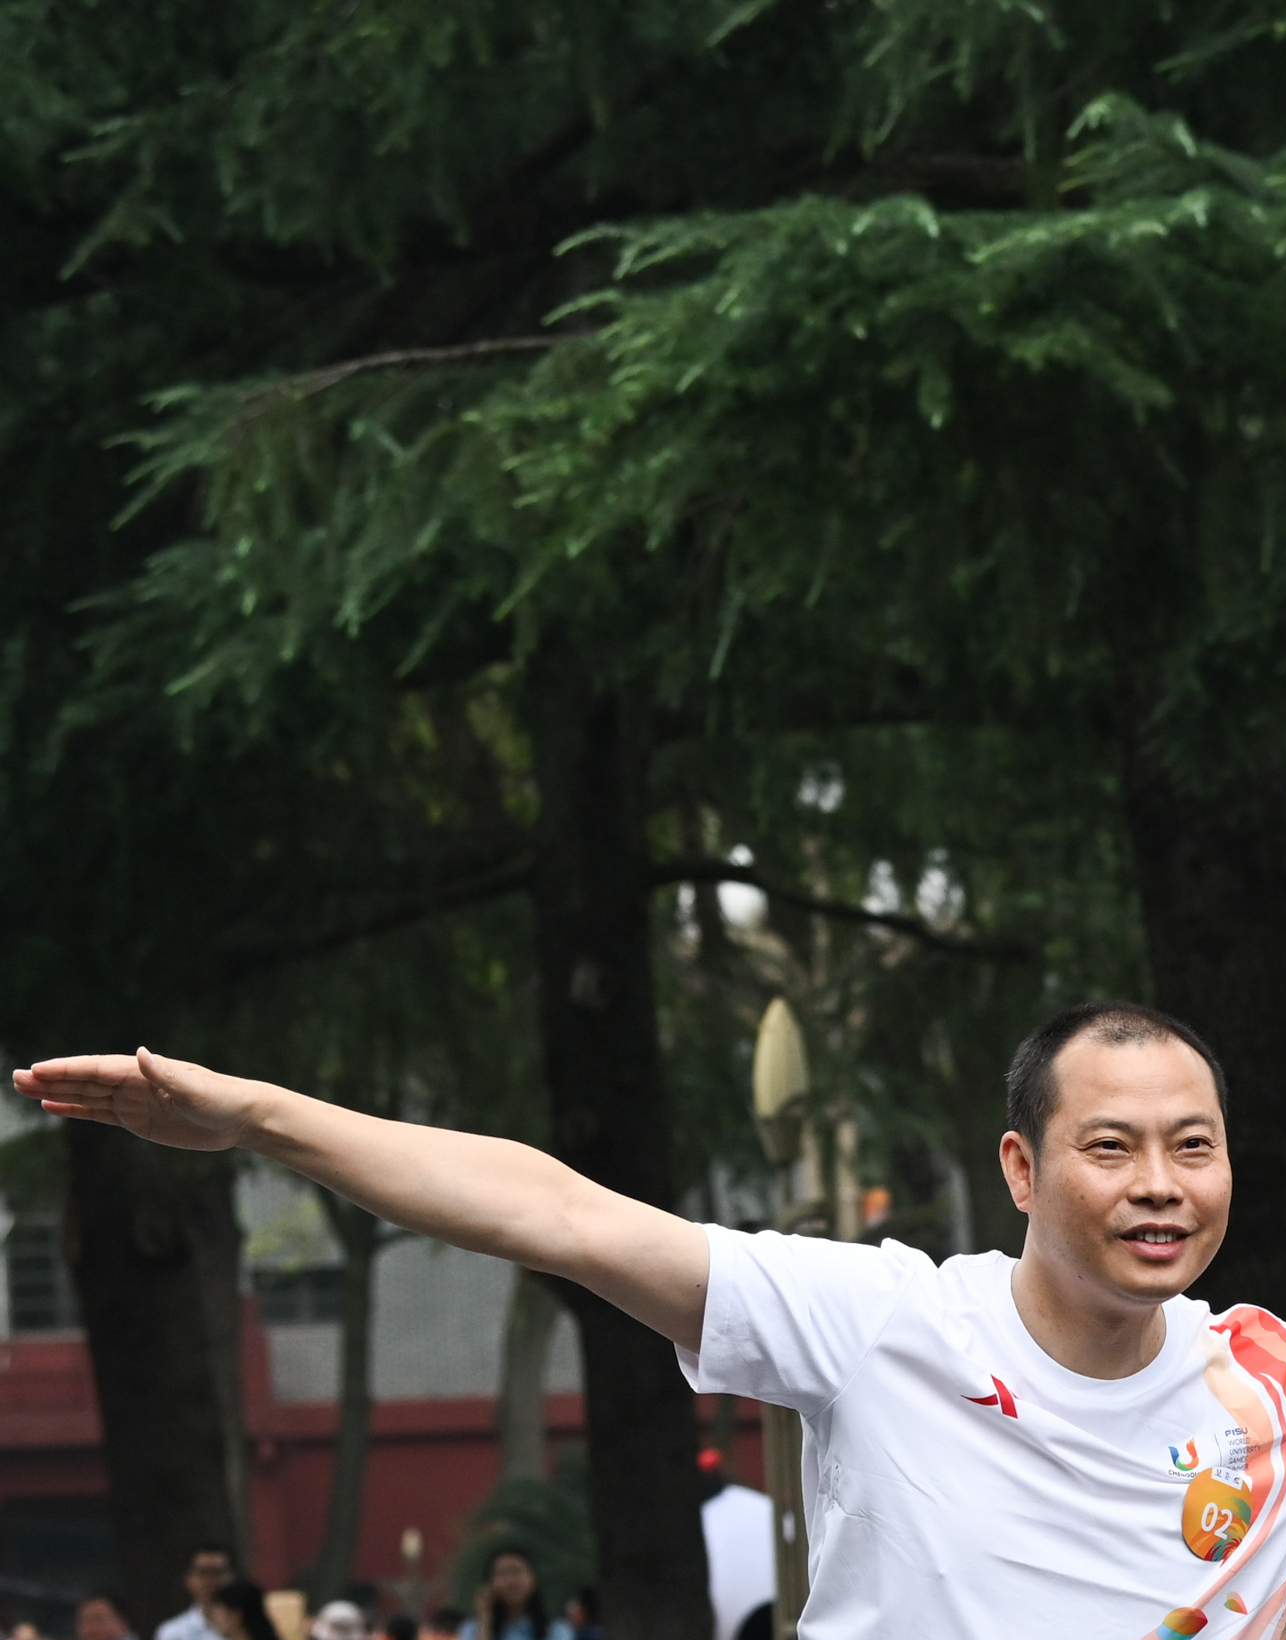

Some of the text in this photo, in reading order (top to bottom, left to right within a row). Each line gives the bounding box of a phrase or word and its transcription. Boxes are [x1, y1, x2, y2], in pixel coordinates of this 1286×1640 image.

[1225, 1427, 1248, 1437] FISU
[1228, 1437, 1251, 1446] WORLD
[1201, 1502, 1233, 1540] 02
